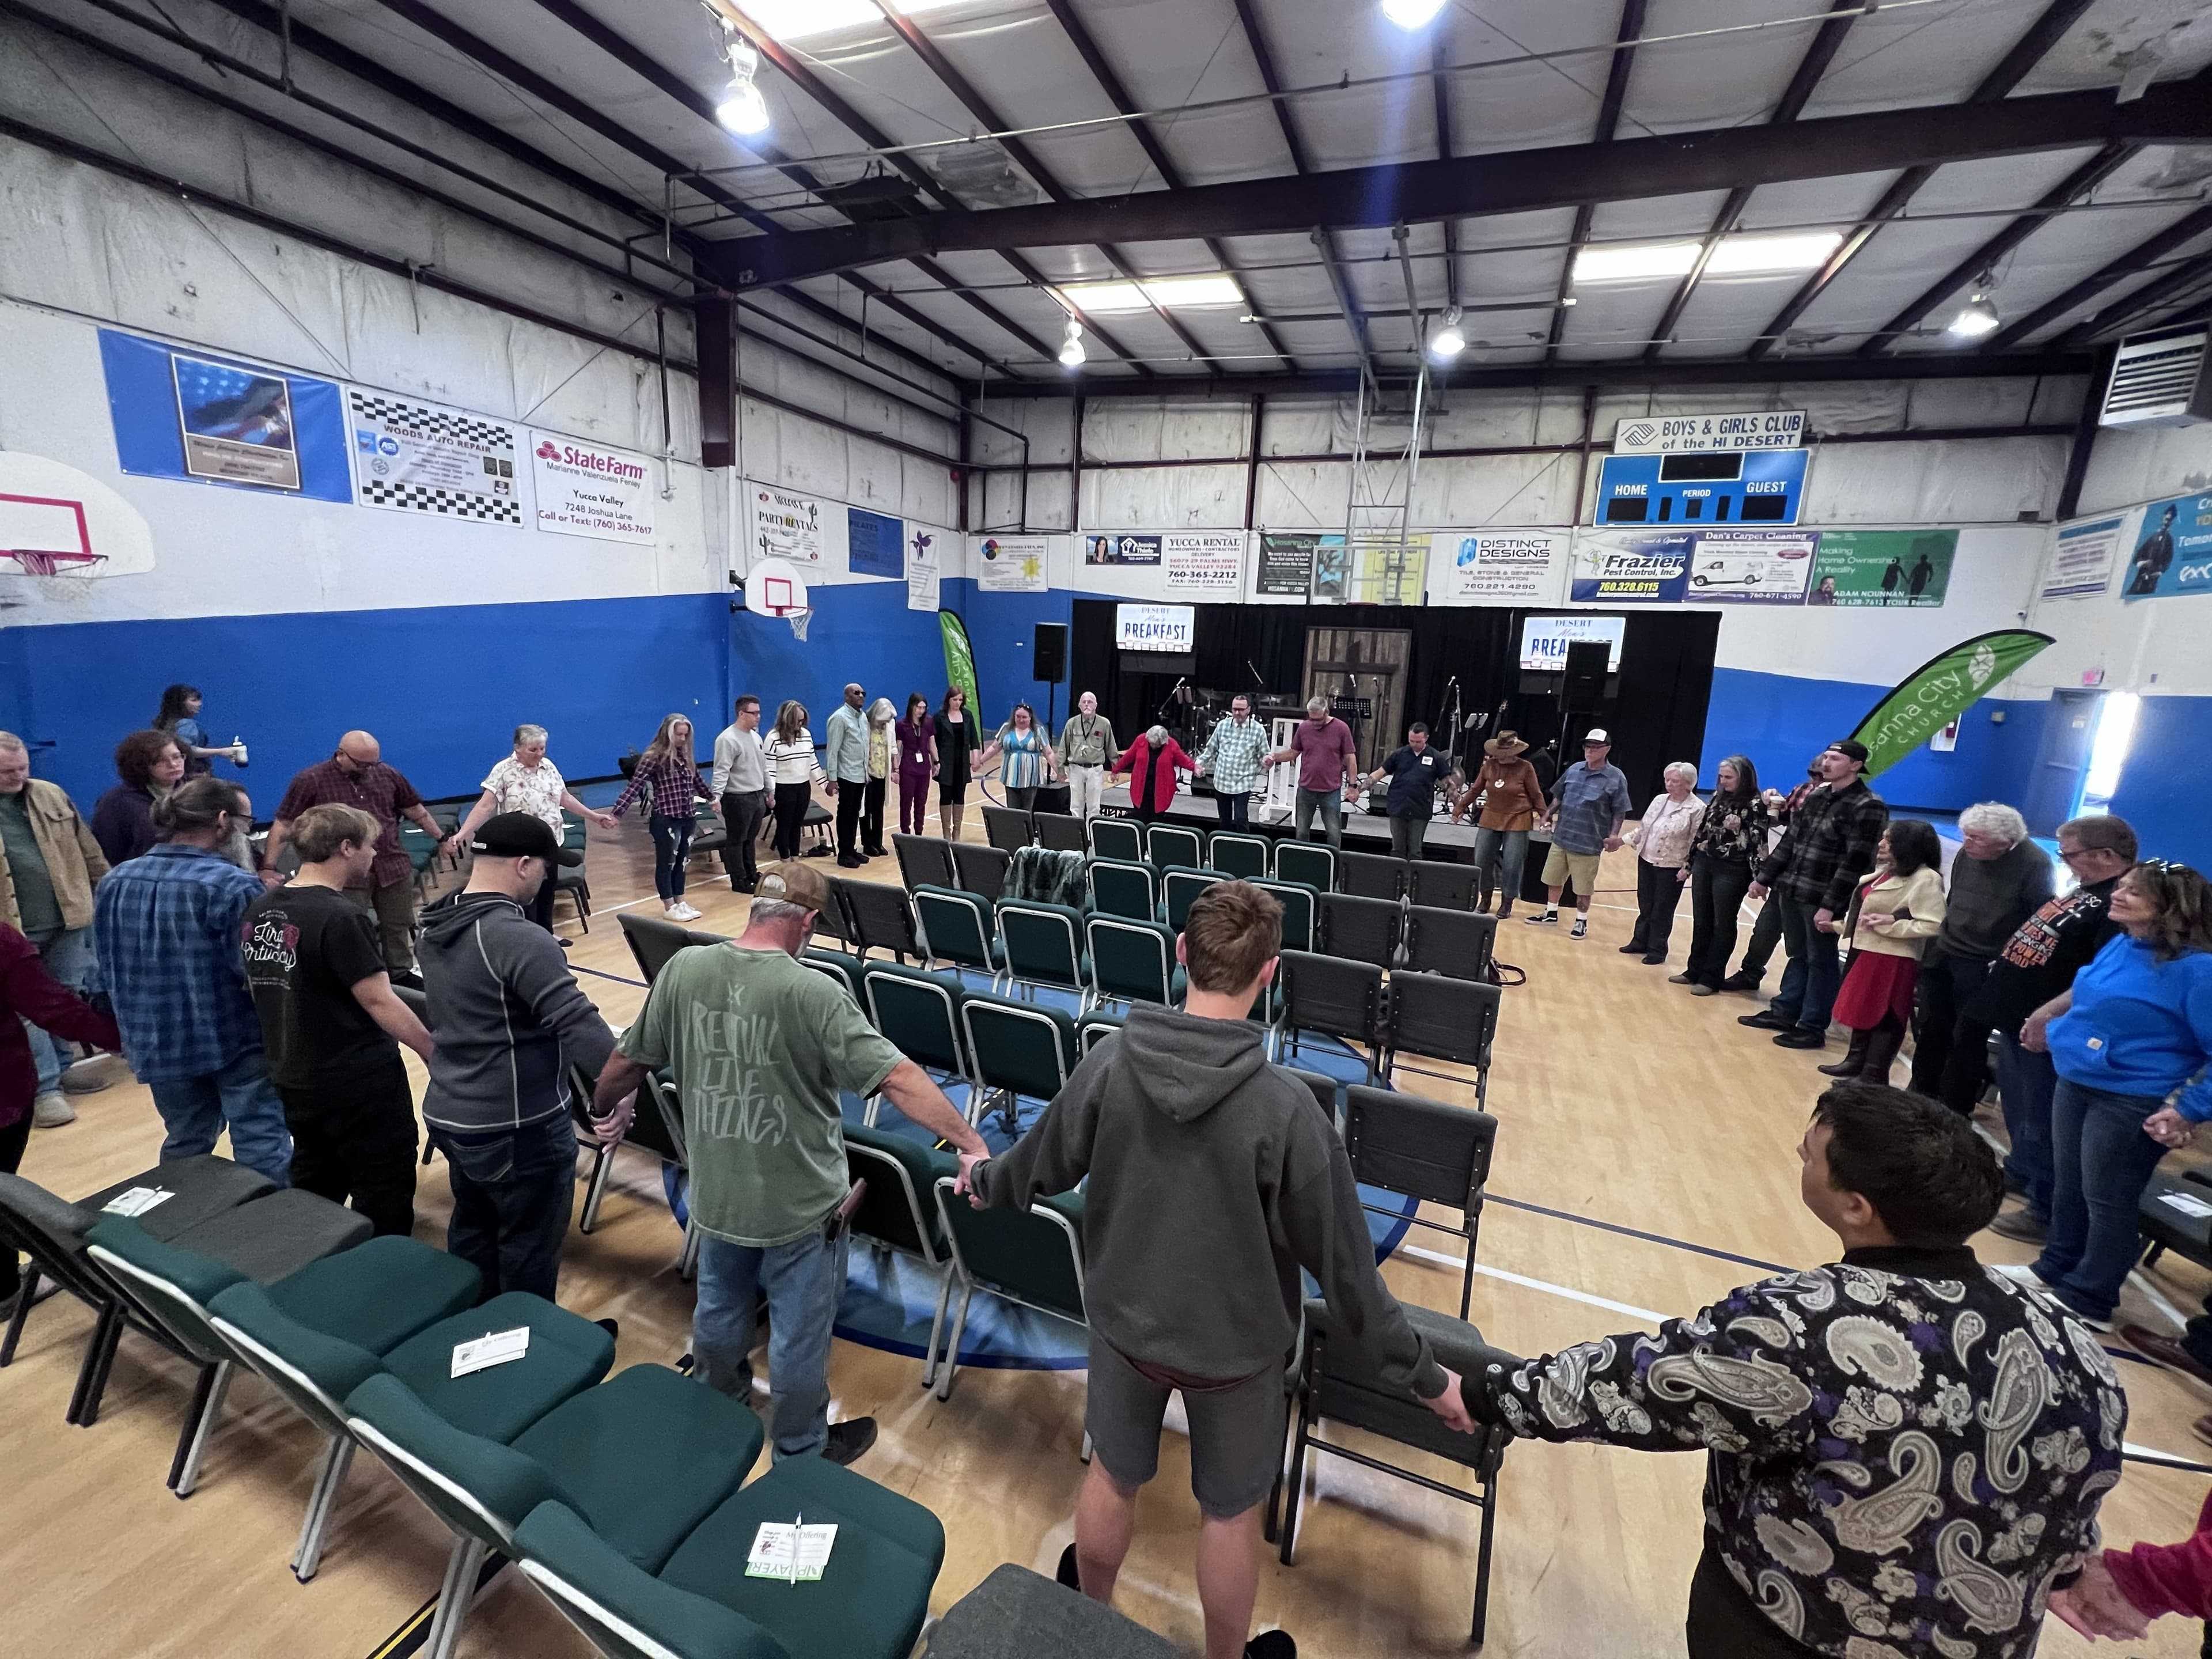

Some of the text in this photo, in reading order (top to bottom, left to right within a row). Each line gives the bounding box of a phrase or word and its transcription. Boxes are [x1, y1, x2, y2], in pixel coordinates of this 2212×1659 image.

[1662, 415, 1801, 437] BOYS & GIRLS CLUB
[384, 424, 491, 453] WOODS AUTO REPAIR
[1662, 434, 1796, 449] of the HI DESERT
[547, 461, 580, 475] Marianne
[582, 469, 618, 484] Valenzuela
[1615, 484, 1647, 496] HOME
[1683, 489, 1711, 498] PERIOD
[1746, 481, 1787, 493] GUEST
[573, 489, 624, 508] Yucca Valley
[565, 502, 632, 520] 7248 Joshua Lane
[759, 511, 783, 525] PARTY
[539, 510, 556, 520] Call
[570, 515, 591, 525] Text:
[593, 519, 615, 531] (760)
[617, 522, 652, 534] 365-7617
[1733, 532, 1763, 540] Carpet
[1766, 532, 1807, 541] Cleaning
[1481, 540, 1552, 548] DISTINCT
[1480, 549, 1550, 558] DESIGNS
[1819, 548, 1853, 556] Making
[1605, 553, 1685, 568] Frazier
[1847, 556, 1897, 565] Ownership
[1624, 569, 1657, 577] Control,
[1599, 582, 1660, 592] 760.328.6115
[1125, 623, 1186, 640] BREAKFAST
[1866, 670, 1962, 763] osanna City
[1897, 691, 1964, 744] CHURCH
